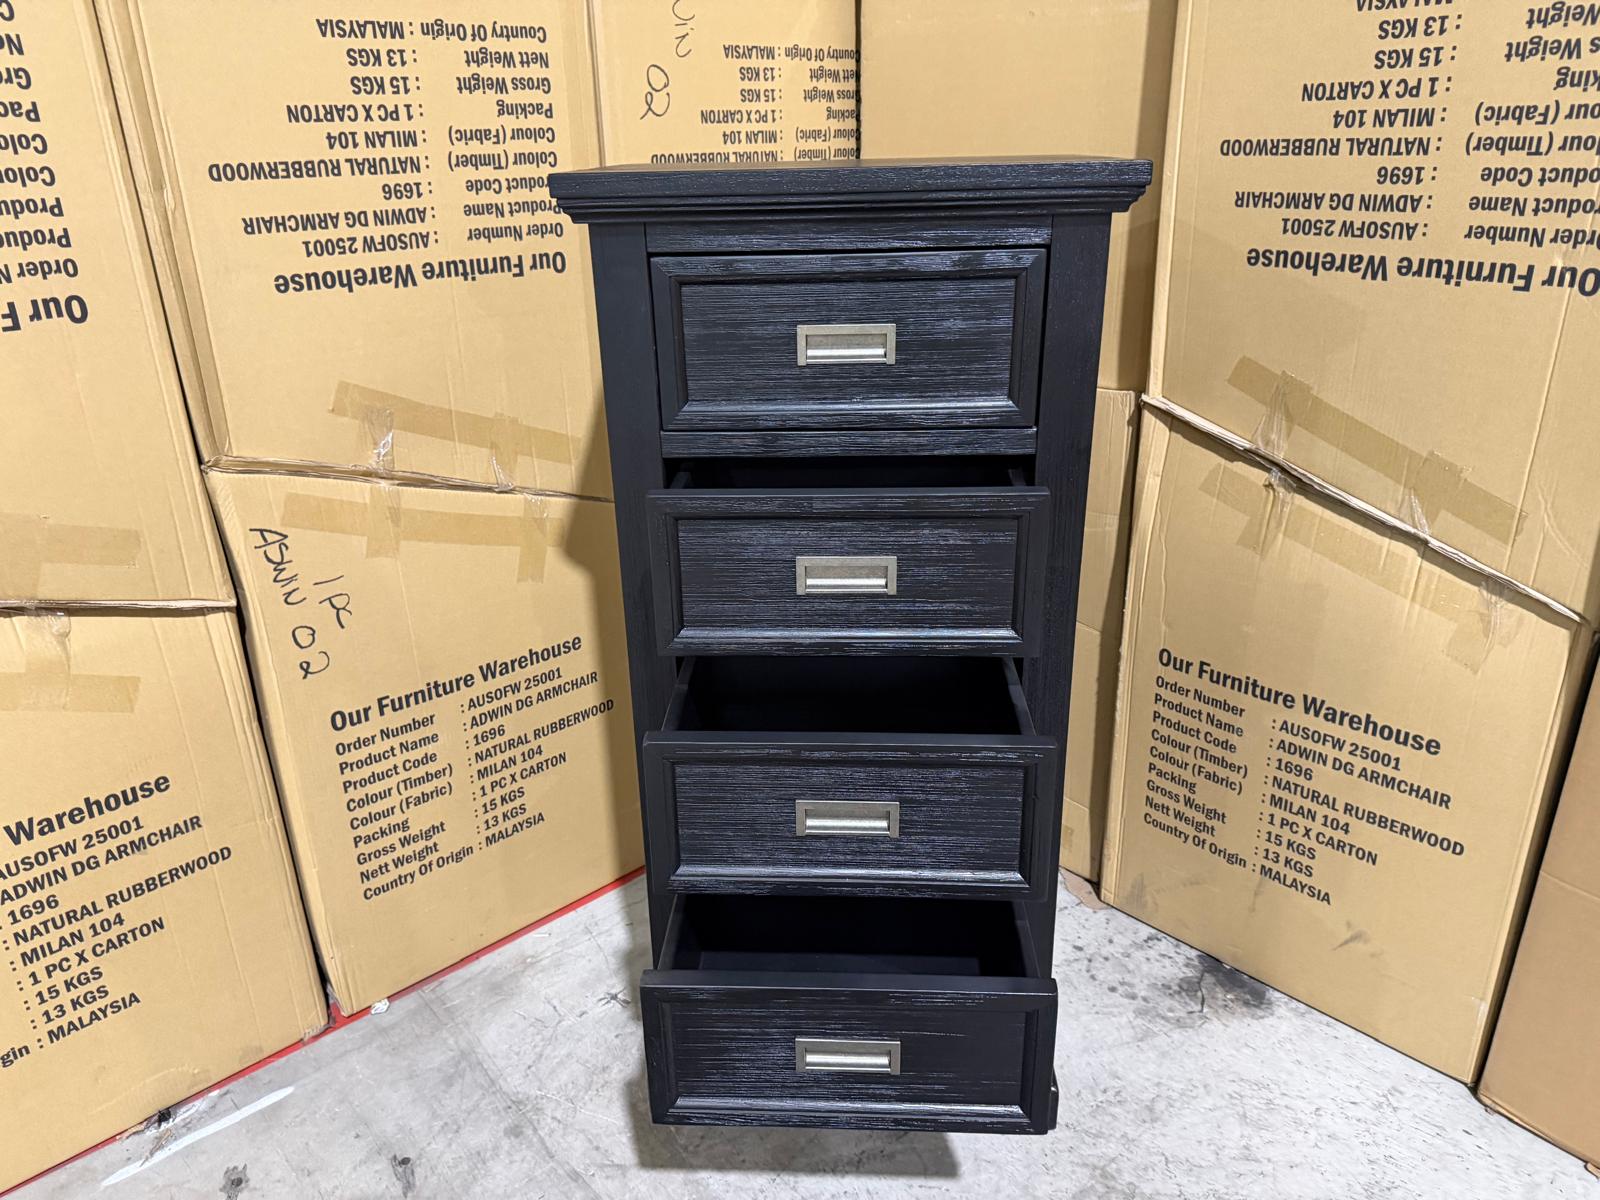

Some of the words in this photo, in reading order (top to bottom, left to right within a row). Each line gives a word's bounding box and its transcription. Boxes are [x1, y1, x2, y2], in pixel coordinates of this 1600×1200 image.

[316, 19, 404, 39] MALAYSIA
[421, 19, 467, 41] Origin
[491, 21, 546, 43] Country
[1378, 18, 1418, 39] KGS
[1424, 16, 1449, 36] 13
[346, 48, 382, 66] KGS
[464, 47, 516, 68] Weight
[518, 52, 549, 68] Nett
[723, 45, 775, 60] MALAYSIA
[1374, 48, 1413, 69] KGS
[1419, 47, 1444, 67] 15
[1504, 36, 1581, 62] Weight
[350, 76, 385, 95] KGS
[456, 73, 509, 94] Weight
[511, 77, 551, 94] Gross
[810, 66, 840, 83] Weight
[804, 87, 834, 102] Weight
[1302, 81, 1374, 101] CARTON
[1395, 78, 1422, 98] PC
[287, 104, 358, 123] CARTON
[496, 100, 553, 119] Packing
[701, 110, 743, 123] CARTON
[1333, 110, 1367, 128] 104
[1373, 108, 1435, 127] MILAN
[1475, 100, 1560, 126] (Fabric)
[326, 132, 359, 149] 104
[364, 130, 417, 148] MILAN
[449, 125, 506, 145] (Fabric)
[510, 127, 555, 143] Colour
[796, 127, 831, 142] (Fabric)
[1466, 131, 1553, 156] (Timber)
[794, 146, 830, 160] (Timber)
[1220, 138, 1341, 156] RUBBERWOOD
[1346, 137, 1430, 156] NATURAL
[208, 159, 341, 182] RUBBERWOOD
[345, 156, 421, 176] NATURAL
[448, 150, 508, 171] (Timber)
[513, 151, 557, 168] Colour
[1377, 166, 1425, 185] 1696
[1481, 167, 1533, 187] Code
[382, 182, 423, 200] 1696
[466, 179, 502, 195] Code
[464, 203, 504, 218] Name
[1235, 191, 1325, 210] ARMCHAIR
[1359, 194, 1423, 213] ADWIN
[1469, 196, 1527, 216] Name
[242, 212, 339, 235] ARMCHAIR
[373, 207, 426, 226] ADWIN
[1282, 218, 1336, 236] 25001
[468, 225, 522, 243] Number
[526, 223, 563, 238] Order
[1338, 220, 1419, 241] AUSOFW
[1464, 225, 1546, 247] Number
[302, 237, 358, 257] 25001
[363, 232, 429, 253] AUSOFW
[17, 258, 78, 280] Order
[422, 255, 524, 281] Furniture
[530, 252, 566, 273] Our
[1247, 248, 1387, 281] Warehouse
[274, 264, 417, 293] Warehouse
[1397, 257, 1535, 292] Furniture
[1541, 266, 1600, 296] Our
[29, 295, 88, 324] Our
[331, 706, 371, 731] Our
[377, 674, 475, 716] Furniture
[479, 637, 581, 682] Warehouse
[468, 681, 521, 711] AUSOFW
[524, 667, 562, 690] 25001
[471, 703, 512, 729] ADWIN
[536, 672, 597, 704] ARMCHAIR
[1156, 676, 1191, 697] Order
[1193, 689, 1245, 717] Number
[1159, 648, 1193, 674] Our
[1198, 661, 1295, 709] Furniture
[1303, 694, 1440, 755] Warehouse
[1155, 693, 1203, 722] Product
[1206, 712, 1243, 737] Name
[336, 734, 376, 755] Order
[380, 714, 435, 741] Number
[474, 724, 505, 746] 1696
[475, 733, 531, 763] NATURAL
[534, 699, 614, 740] RUBBERWOOD
[1153, 711, 1201, 740] Product
[1204, 731, 1236, 753] Code
[339, 746, 397, 775] Product
[399, 734, 439, 754] Name
[1152, 729, 1191, 753] Colour
[1194, 746, 1247, 779] (Timber)
[1279, 720, 1346, 751] AUSOFW
[1348, 743, 1400, 771] 25001
[343, 764, 400, 793] Product
[403, 753, 437, 771] Code
[477, 755, 516, 780] MILAN
[520, 752, 566, 779] CARTON
[1150, 746, 1189, 770] Colour
[1192, 763, 1242, 795] (Fabric)
[1276, 758, 1313, 781] 1696
[1276, 739, 1328, 766] ADWIN
[1357, 767, 1451, 809] ARMCHAIR
[347, 787, 393, 812] Colour
[397, 763, 452, 795] (Timber)
[1148, 762, 1196, 794] Packing
[3, 776, 170, 845] Warehouse
[350, 806, 396, 830] Colour
[400, 782, 452, 814] (Fabric)
[1147, 780, 1180, 803] Gross
[1184, 794, 1226, 824] Weight
[1146, 795, 1170, 816] Nett
[1173, 808, 1215, 837] Weight
[1270, 794, 1316, 822] MILAN
[1321, 815, 1350, 835] 104
[1272, 776, 1339, 812] NATURAL
[1343, 802, 1464, 855] RUBBERWOOD
[82, 816, 144, 850] 25001
[353, 818, 410, 848] Packing
[486, 813, 544, 847] MALAYSIA
[1144, 813, 1189, 843] Country
[1209, 843, 1246, 868] Origin
[357, 843, 396, 865] Gross
[399, 821, 445, 848] Weight
[1287, 839, 1316, 860] KGS
[1316, 832, 1377, 865] CARTON
[1, 867, 67, 905] ADWIN
[71, 855, 100, 876] DG
[105, 816, 202, 864] ARMCHAIR
[360, 862, 390, 884] Nett
[392, 842, 439, 869] Weight
[1284, 856, 1313, 877] KGS
[364, 871, 415, 900] Country
[437, 846, 473, 868] Origin
[1260, 864, 1330, 905] MALAYSIA
[13, 901, 103, 946] NATURAL
[106, 847, 231, 908] RUBBERWOOD
[8, 894, 59, 925] 1696
[20, 929, 84, 966] MILAN
[89, 913, 124, 937] 104
[45, 957, 72, 979] PC
[92, 917, 164, 957] CARTON
[36, 984, 60, 1005] 15
[64, 967, 103, 992] KGS
[42, 1004, 66, 1024] 13
[70, 985, 109, 1011] KGS
[47, 993, 140, 1043] MALAYSIA
